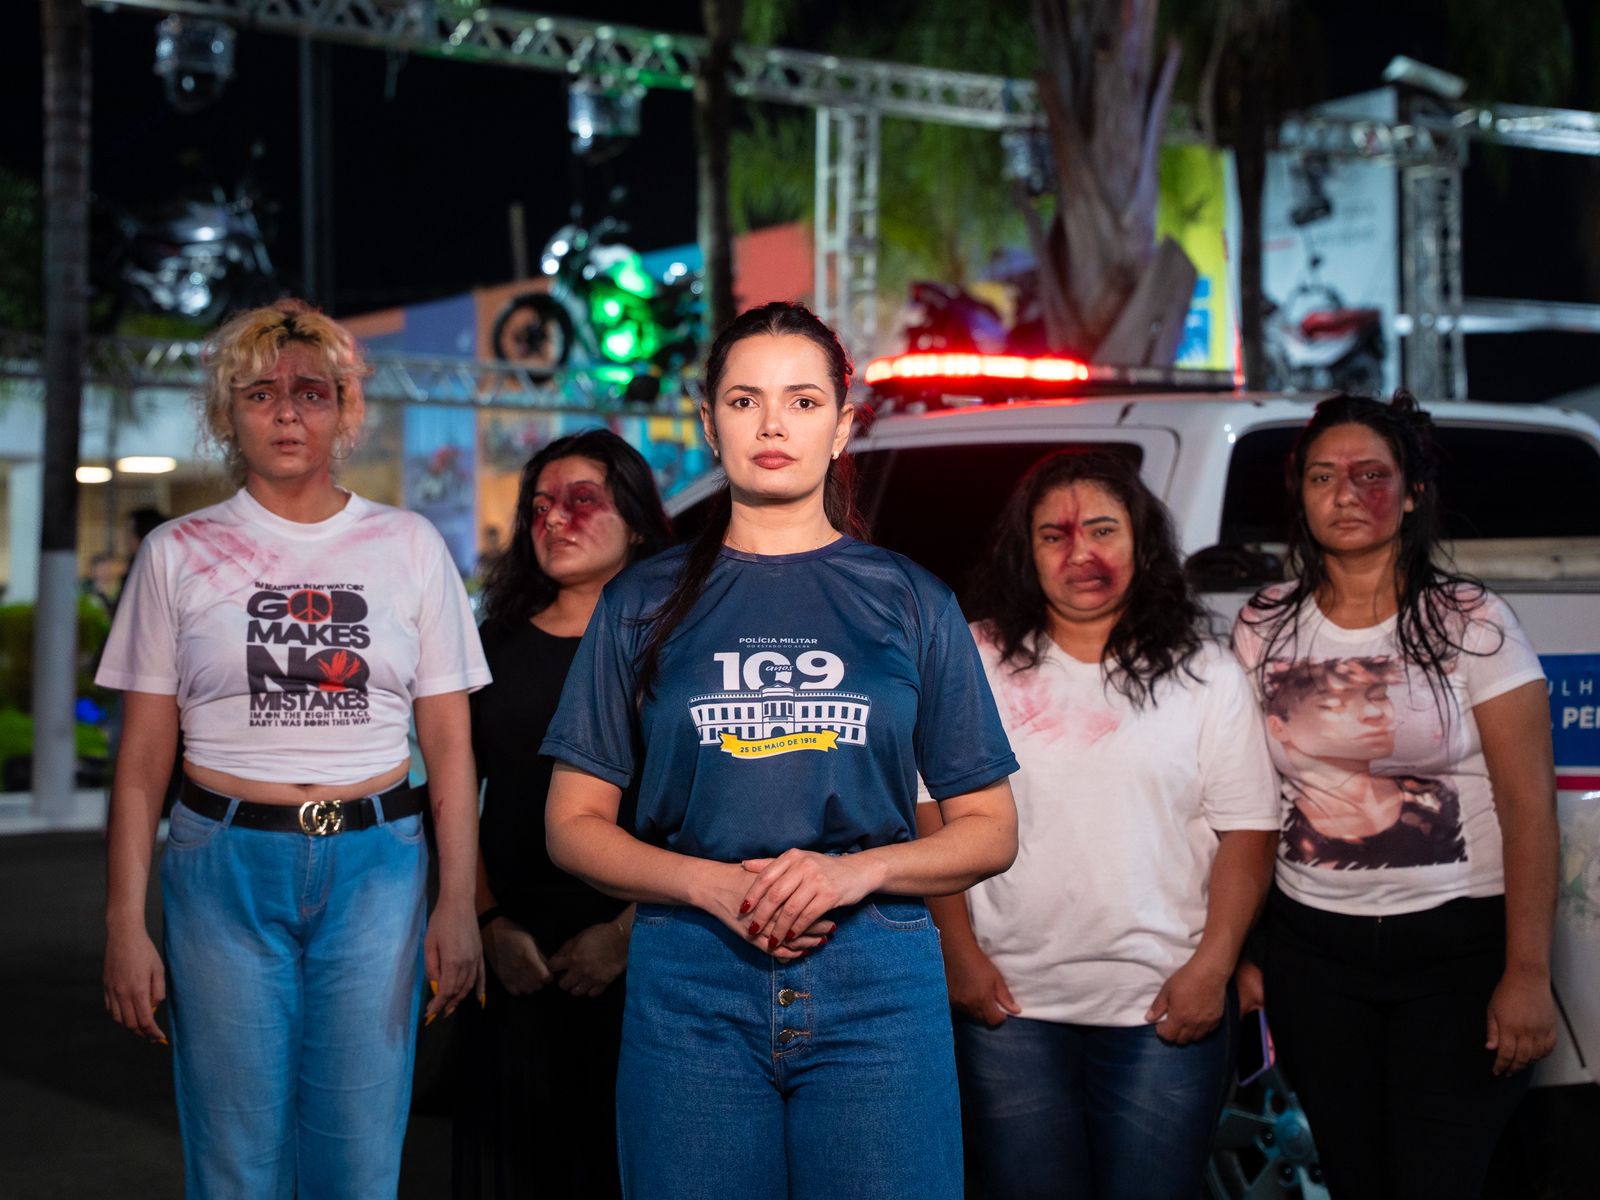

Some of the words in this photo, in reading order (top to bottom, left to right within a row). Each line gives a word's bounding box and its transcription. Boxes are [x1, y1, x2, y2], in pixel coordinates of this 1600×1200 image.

[326, 583, 345, 591] WAY
[247, 590, 368, 624] GOD
[247, 620, 371, 649] MAKES
[739, 636, 777, 644] POLÍCIA
[780, 637, 818, 645] MILITAR
[247, 645, 370, 693] NO
[713, 650, 845, 691] 109
[765, 664, 794, 673] anos
[250, 690, 370, 711] MISTAKES
[249, 719, 272, 727] BABY
[280, 719, 301, 727] WAS
[304, 719, 330, 727] BORN
[332, 718, 350, 726] THIS
[352, 717, 372, 725] WAY
[265, 711, 281, 719] ON
[284, 711, 301, 719] THE
[305, 711, 335, 719] RIGHT
[1562, 705, 1600, 730] PE
[752, 745, 762, 753] DE
[764, 742, 785, 750] MAIO
